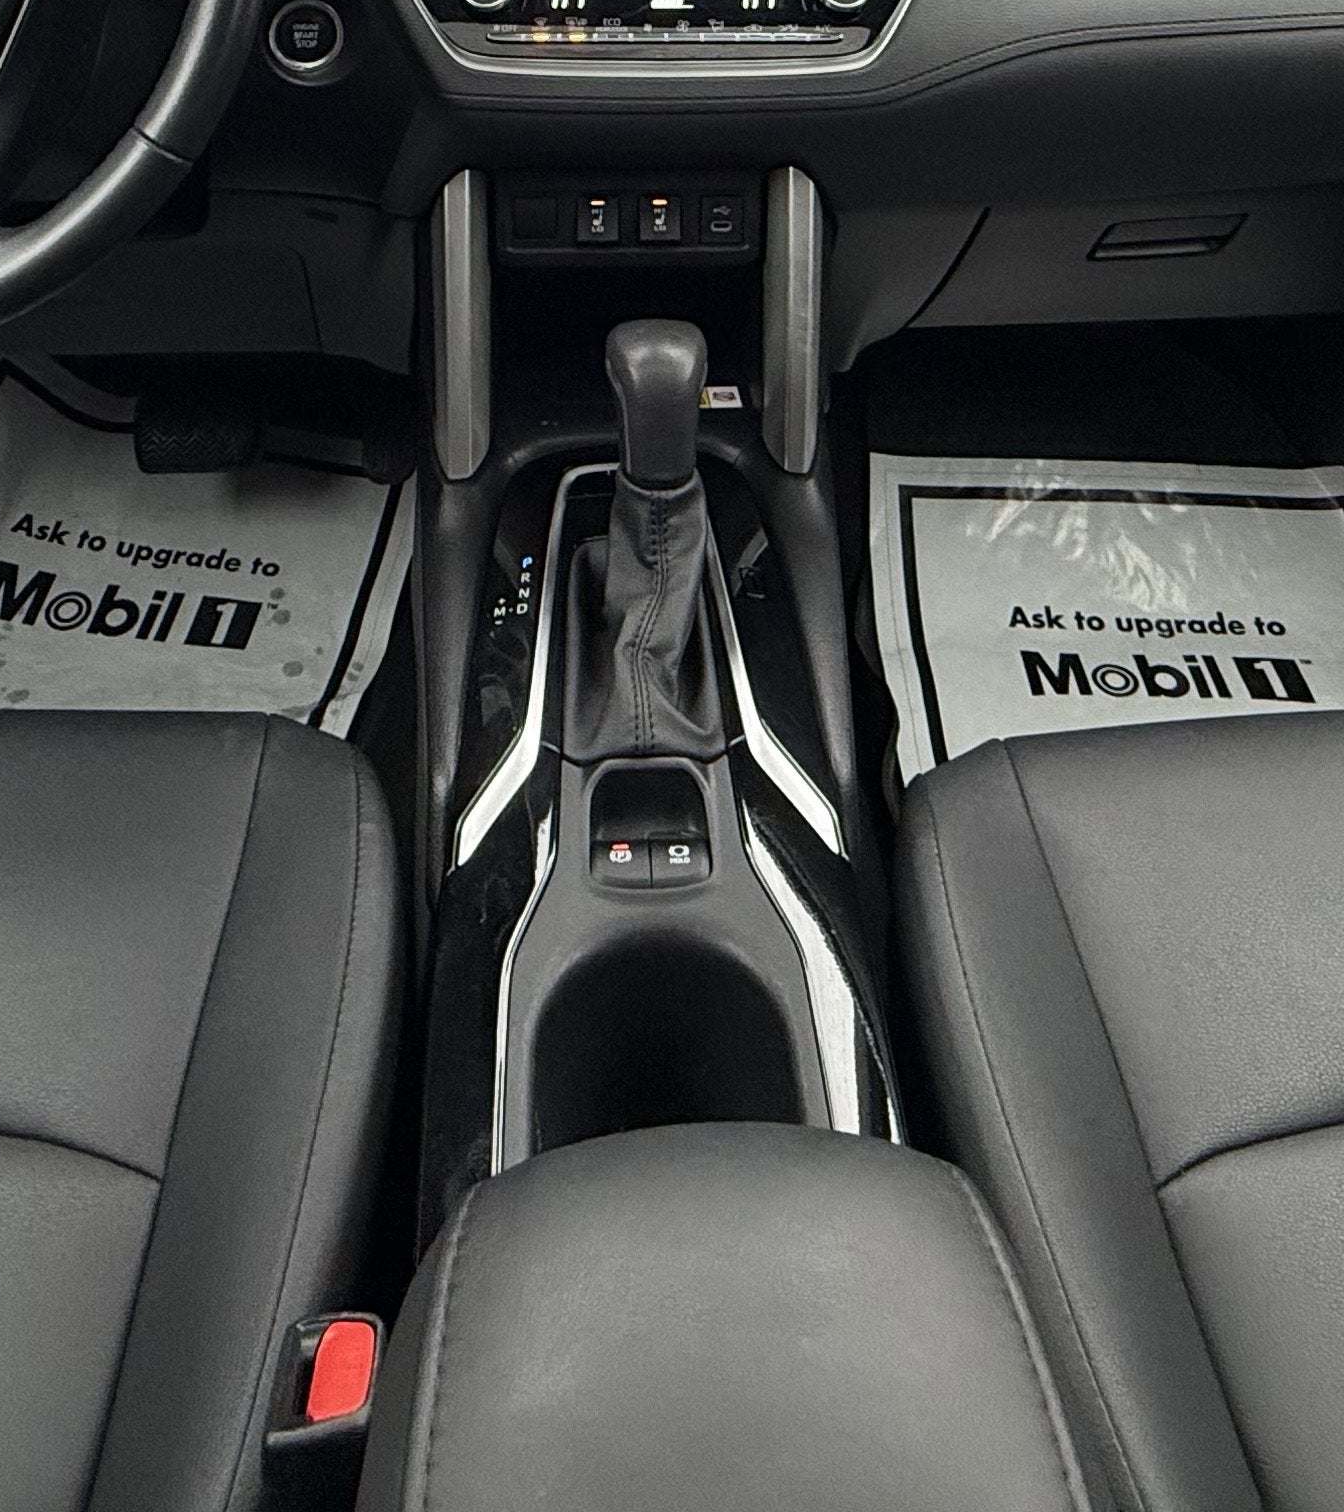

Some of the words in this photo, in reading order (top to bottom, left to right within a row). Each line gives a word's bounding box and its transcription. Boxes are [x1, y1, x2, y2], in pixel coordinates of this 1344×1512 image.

[602, 17, 622, 26] ECO
[293, 31, 318, 40] START
[295, 39, 318, 49] STOP
[10, 513, 70, 546] Ask
[77, 529, 106, 552] to
[116, 540, 241, 573] upgrade
[251, 557, 280, 578] to
[521, 555, 533, 569] P
[520, 572, 531, 583] R
[518, 587, 530, 599] N
[493, 606, 506, 617] M
[515, 603, 528, 615] D
[1009, 605, 1066, 630] Ask
[1074, 610, 1105, 632] to
[1116, 612, 1246, 639] upgrade
[1255, 617, 1287, 637] to
[1020, 650, 1233, 699] Mobil
